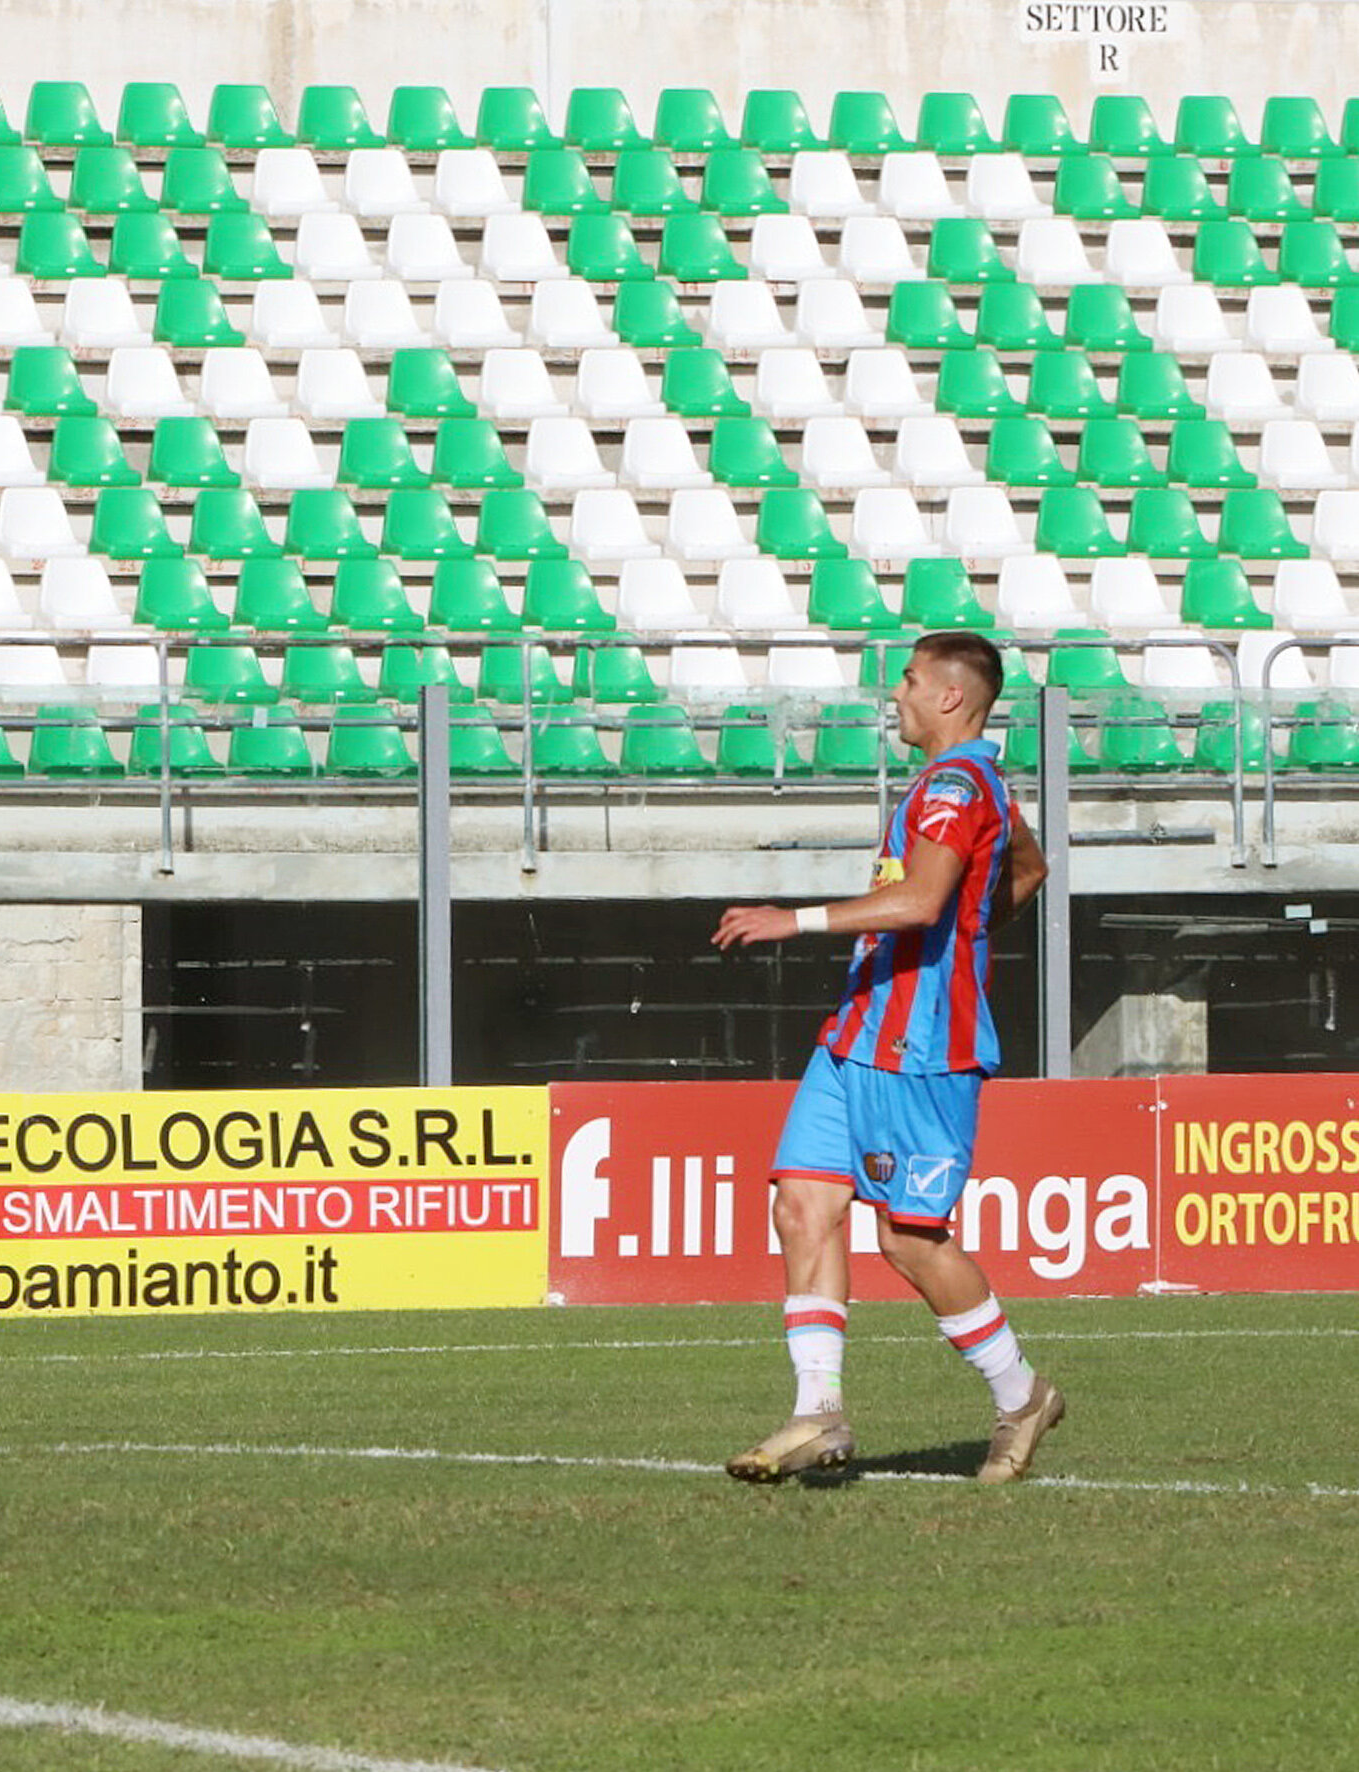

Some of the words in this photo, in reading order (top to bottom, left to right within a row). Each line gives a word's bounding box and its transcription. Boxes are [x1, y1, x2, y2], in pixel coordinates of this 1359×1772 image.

[1026, 5, 1167, 33] SETTORE
[1099, 44, 1119, 72] R
[349, 1108, 534, 1168] S.R.L.
[2, 1186, 353, 1234] SMALTIMENTO
[369, 1184, 531, 1228] RIFIUTI
[561, 1117, 734, 1257] f.lli
